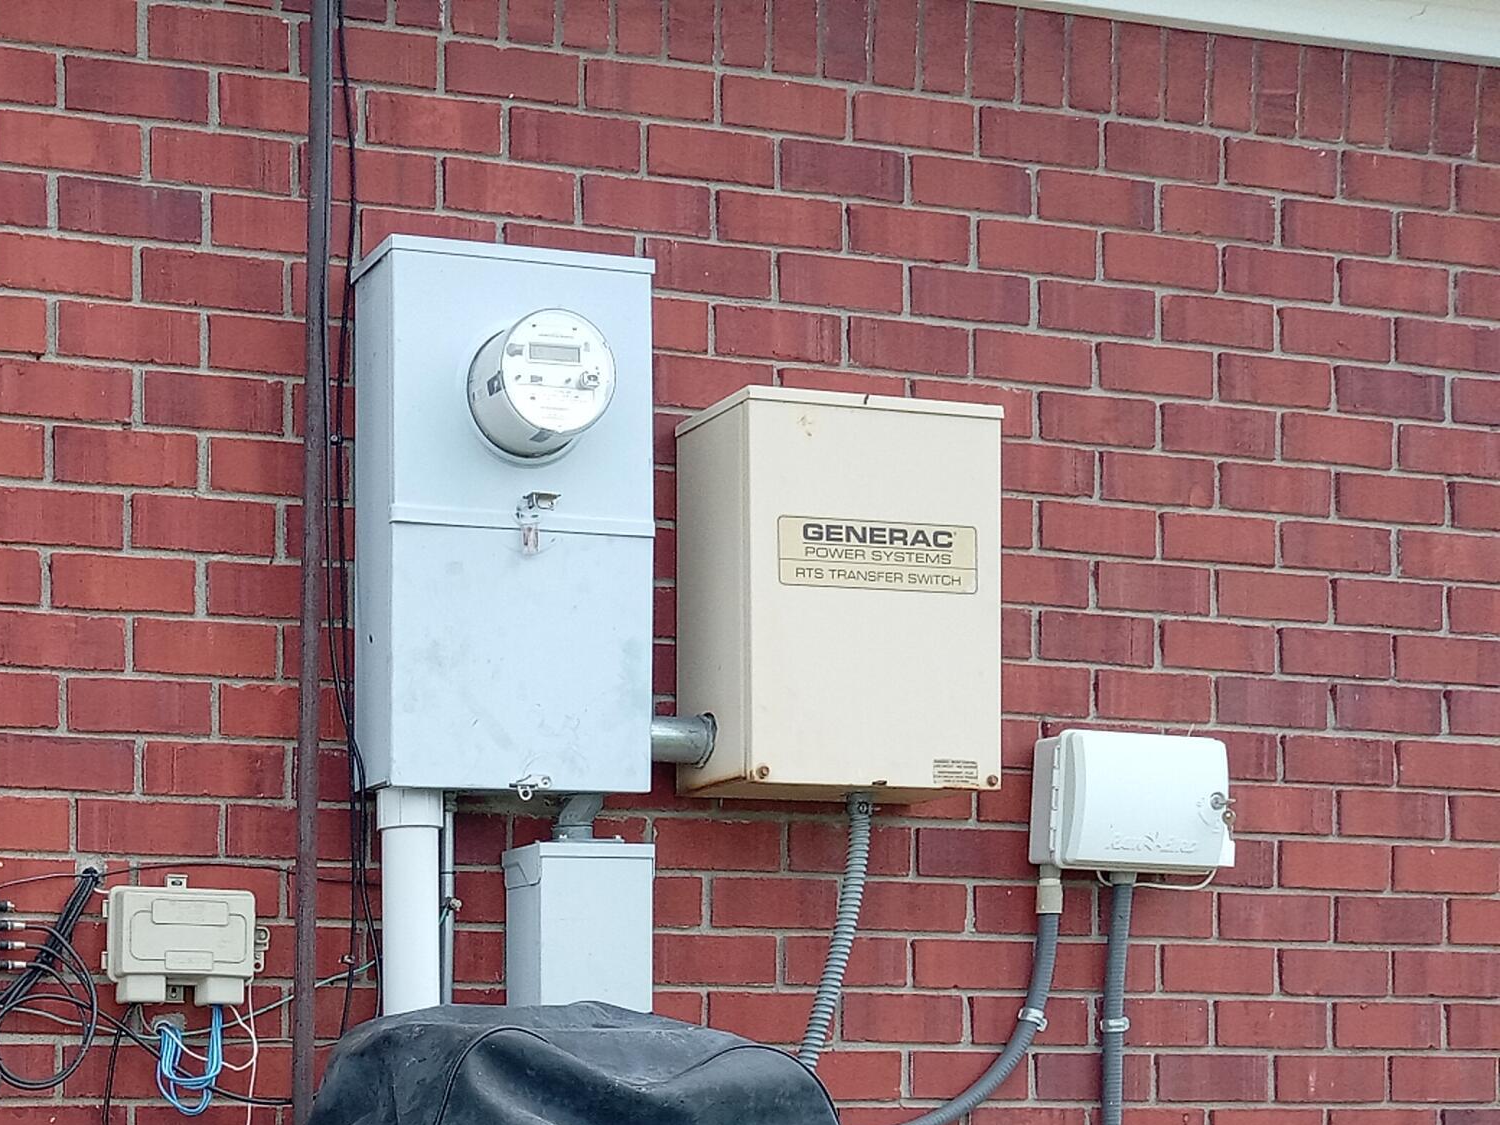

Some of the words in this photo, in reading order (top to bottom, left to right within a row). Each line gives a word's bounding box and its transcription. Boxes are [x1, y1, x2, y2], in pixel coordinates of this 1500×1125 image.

[802, 523, 954, 548] GENERAC
[804, 546, 866, 561] POWER
[871, 550, 952, 565] SYSTEMS
[795, 567, 824, 579] RTS
[828, 568, 904, 584] TRANSFER
[907, 573, 962, 587] SWITCH
